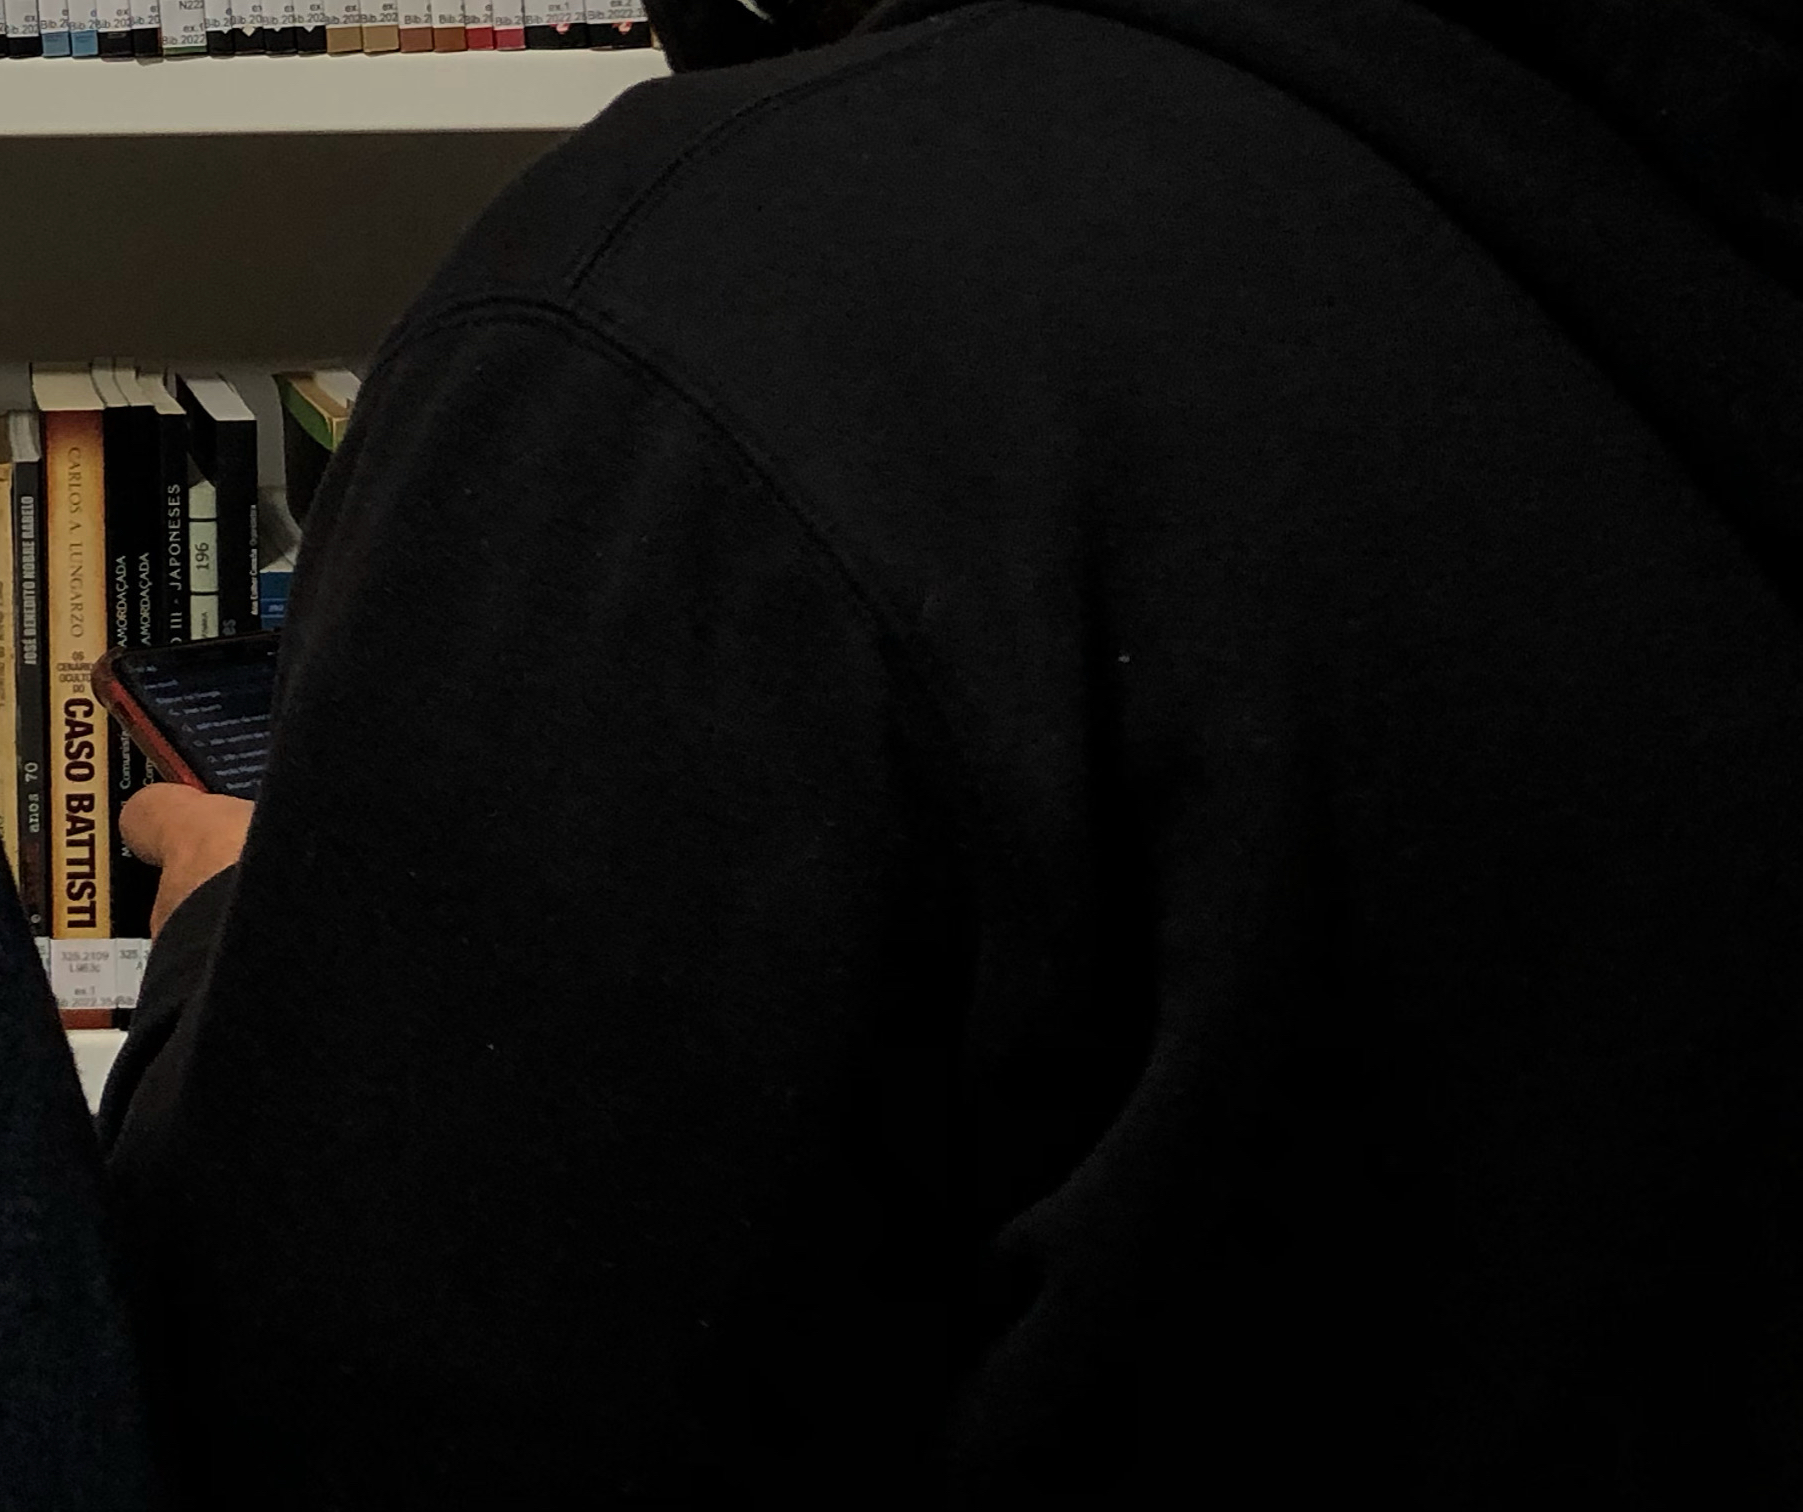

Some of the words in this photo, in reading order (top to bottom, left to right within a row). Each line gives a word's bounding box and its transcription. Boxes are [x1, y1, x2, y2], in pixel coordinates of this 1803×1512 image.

[68, 447, 83, 513] CARLOS
[168, 484, 182, 590] JAPONESES
[195, 543, 209, 570] 196
[69, 543, 84, 638] LUNGARZO
[115, 556, 128, 647] AMORDAÇADA
[24, 762, 39, 782] 70
[63, 698, 96, 782] CASO
[26, 794, 40, 833] anos
[65, 793, 97, 928] BATTISTI
